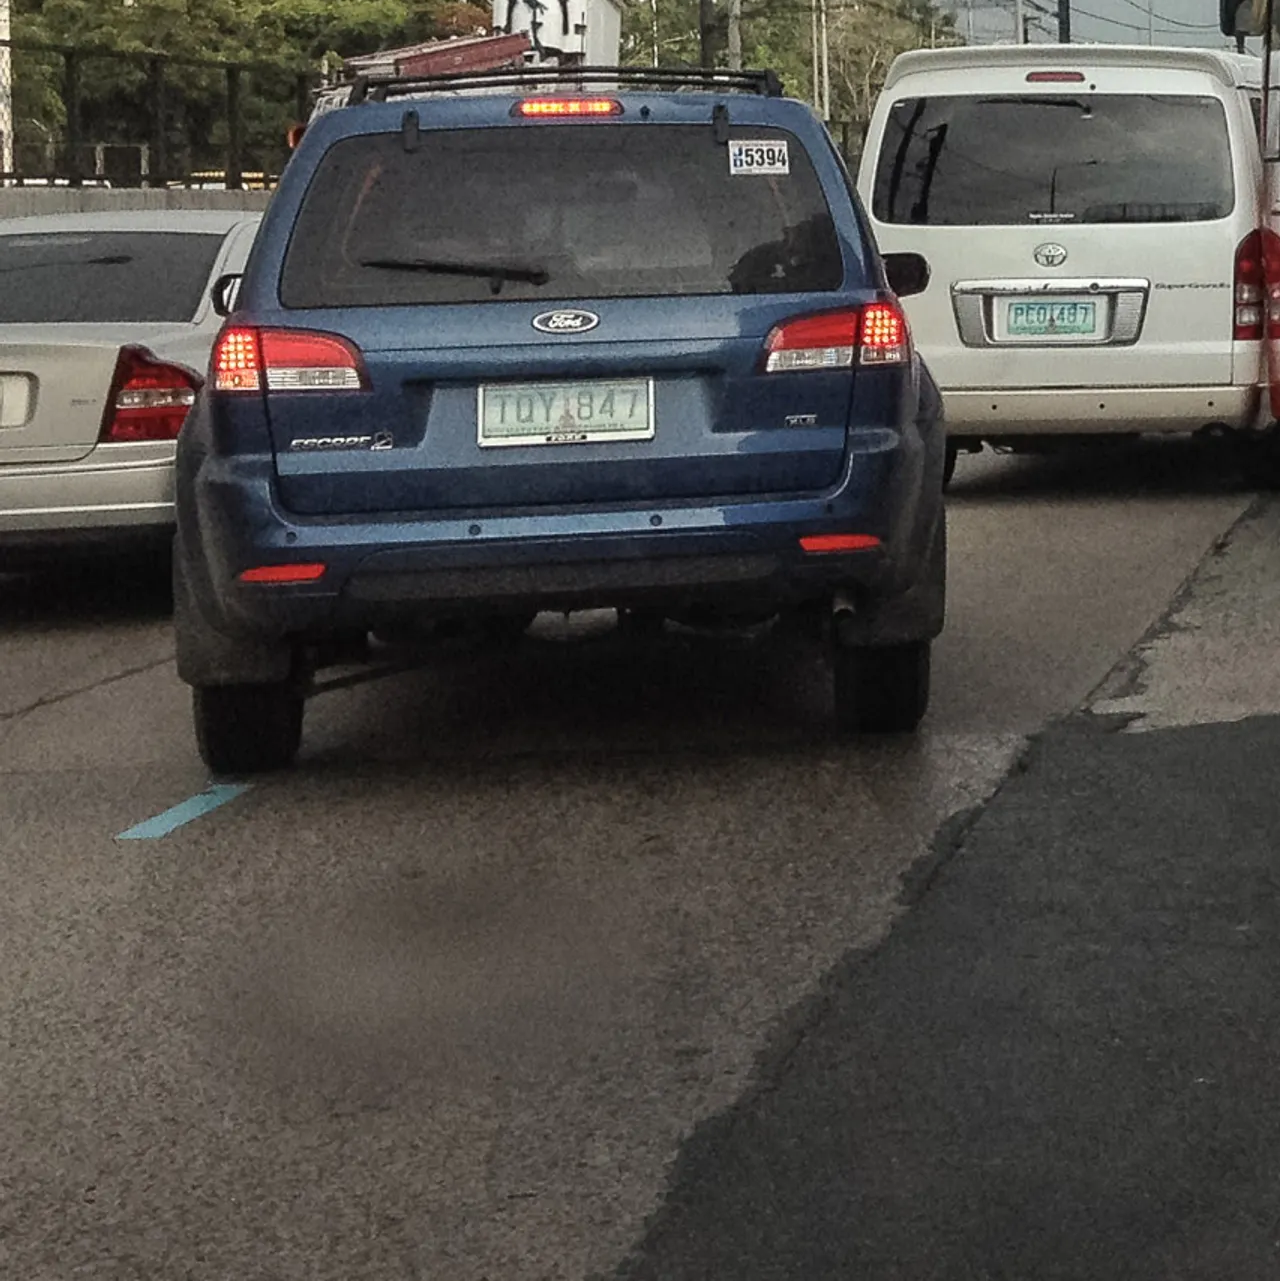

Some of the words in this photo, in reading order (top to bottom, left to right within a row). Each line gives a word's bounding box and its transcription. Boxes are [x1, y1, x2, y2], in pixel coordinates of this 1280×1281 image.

[744, 148, 787, 167] 5394
[547, 312, 583, 328] Ford
[577, 389, 640, 421] 847
